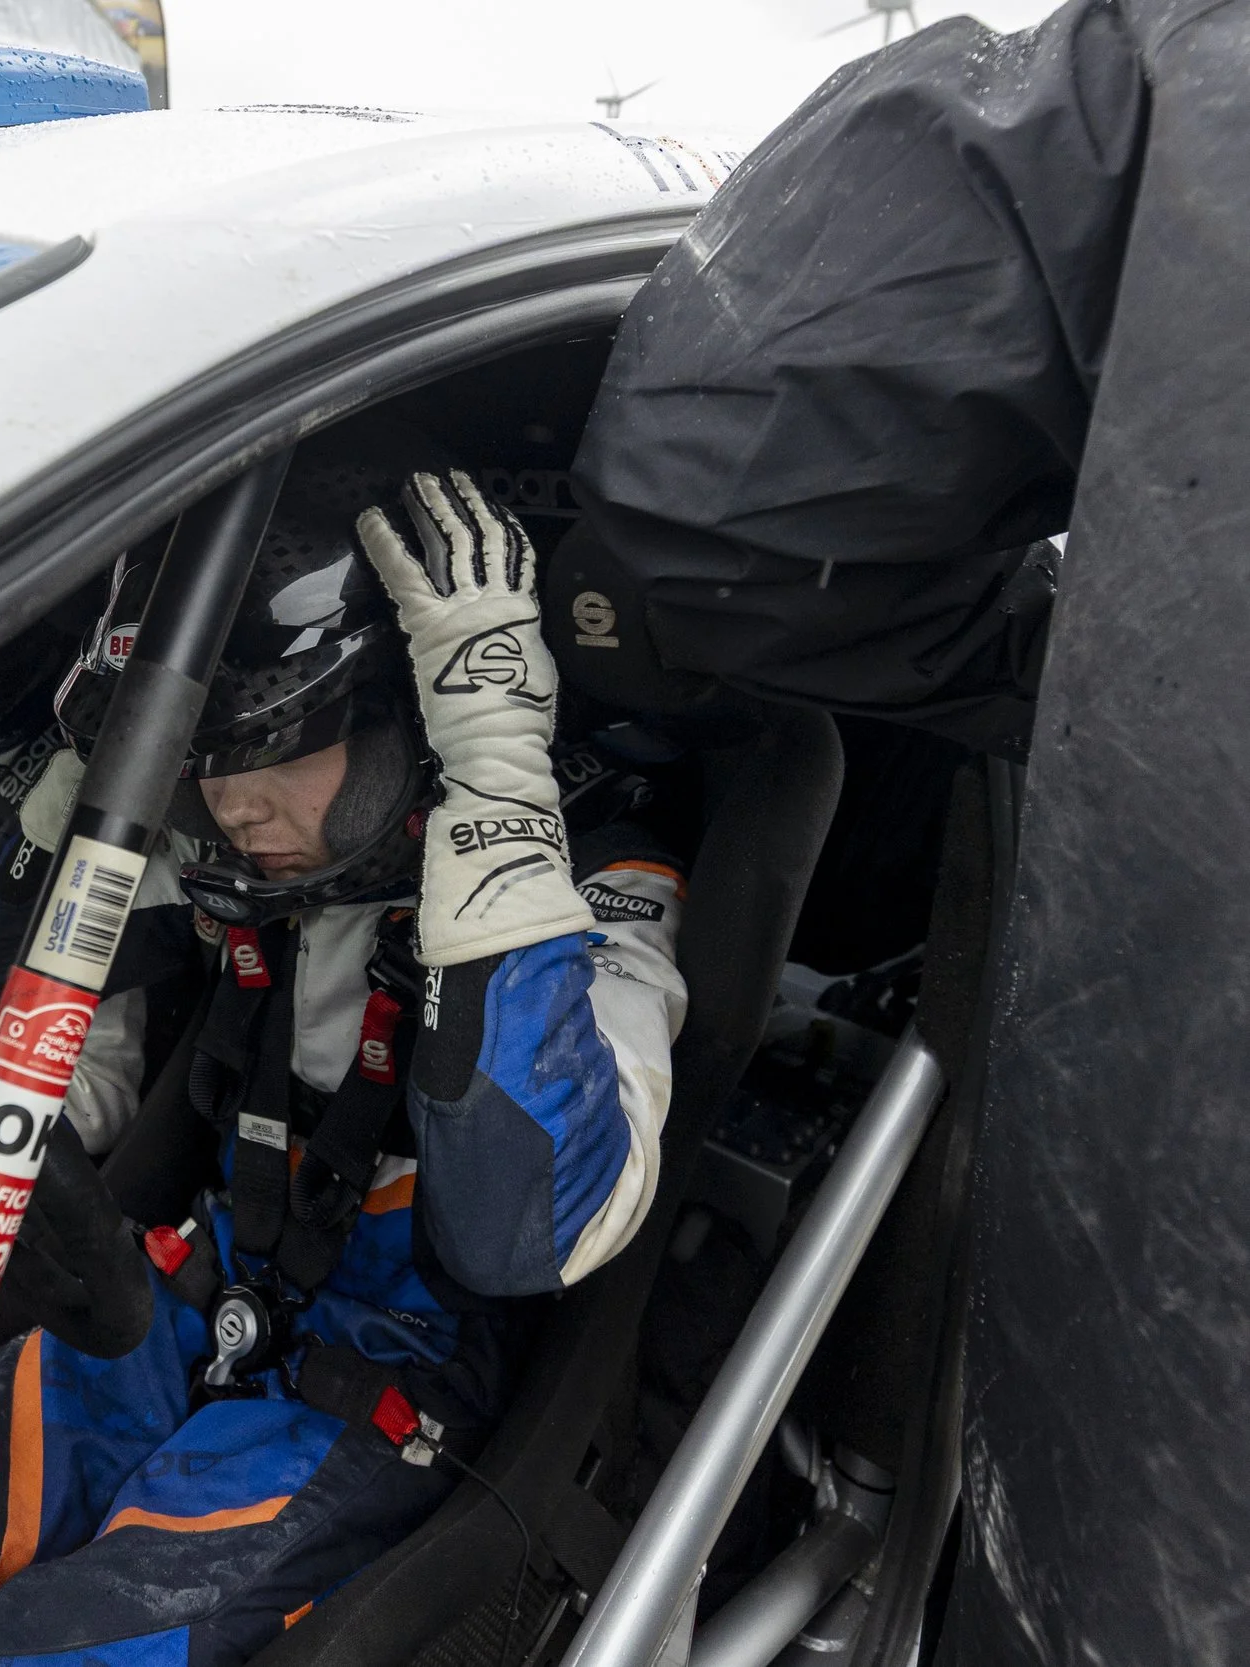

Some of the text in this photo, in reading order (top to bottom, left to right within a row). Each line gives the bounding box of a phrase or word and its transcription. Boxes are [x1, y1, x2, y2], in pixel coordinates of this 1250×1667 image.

[110, 635, 135, 656] BE
[450, 817, 564, 855] sparco
[576, 886, 658, 917] NKOOK
